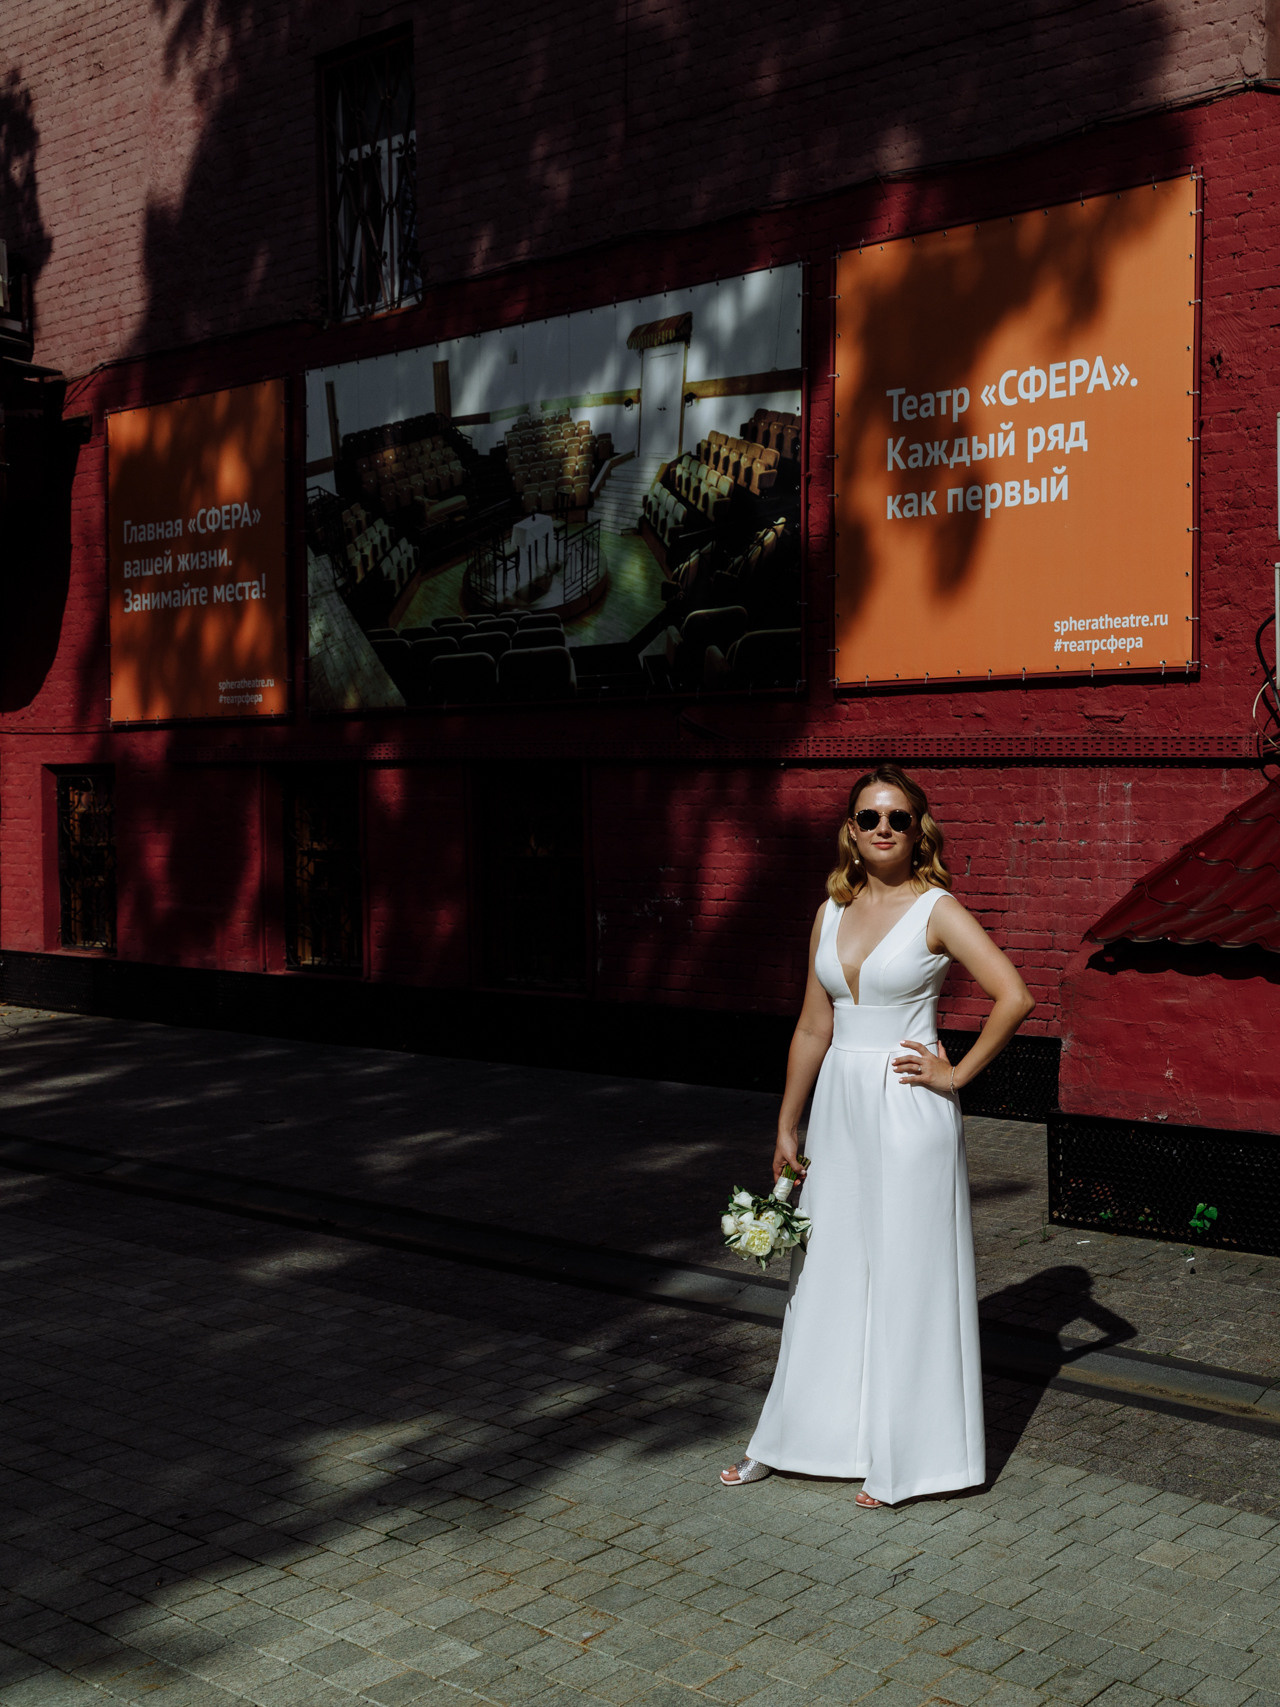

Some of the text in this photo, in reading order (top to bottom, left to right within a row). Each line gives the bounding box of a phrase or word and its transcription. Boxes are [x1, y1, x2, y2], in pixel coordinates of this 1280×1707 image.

[886, 354, 1138, 423] Театр «СФЕРА».
[886, 418, 1088, 472] Каждый ряд
[886, 465, 1069, 520] как первый
[123, 501, 262, 545] Главная «СФЕРА»
[123, 548, 233, 579] вашей жизни.
[123, 573, 267, 613] Занимайте места!
[1053, 611, 1169, 636] spheratheatre.ru
[1053, 635, 1144, 654] #театрсфера
